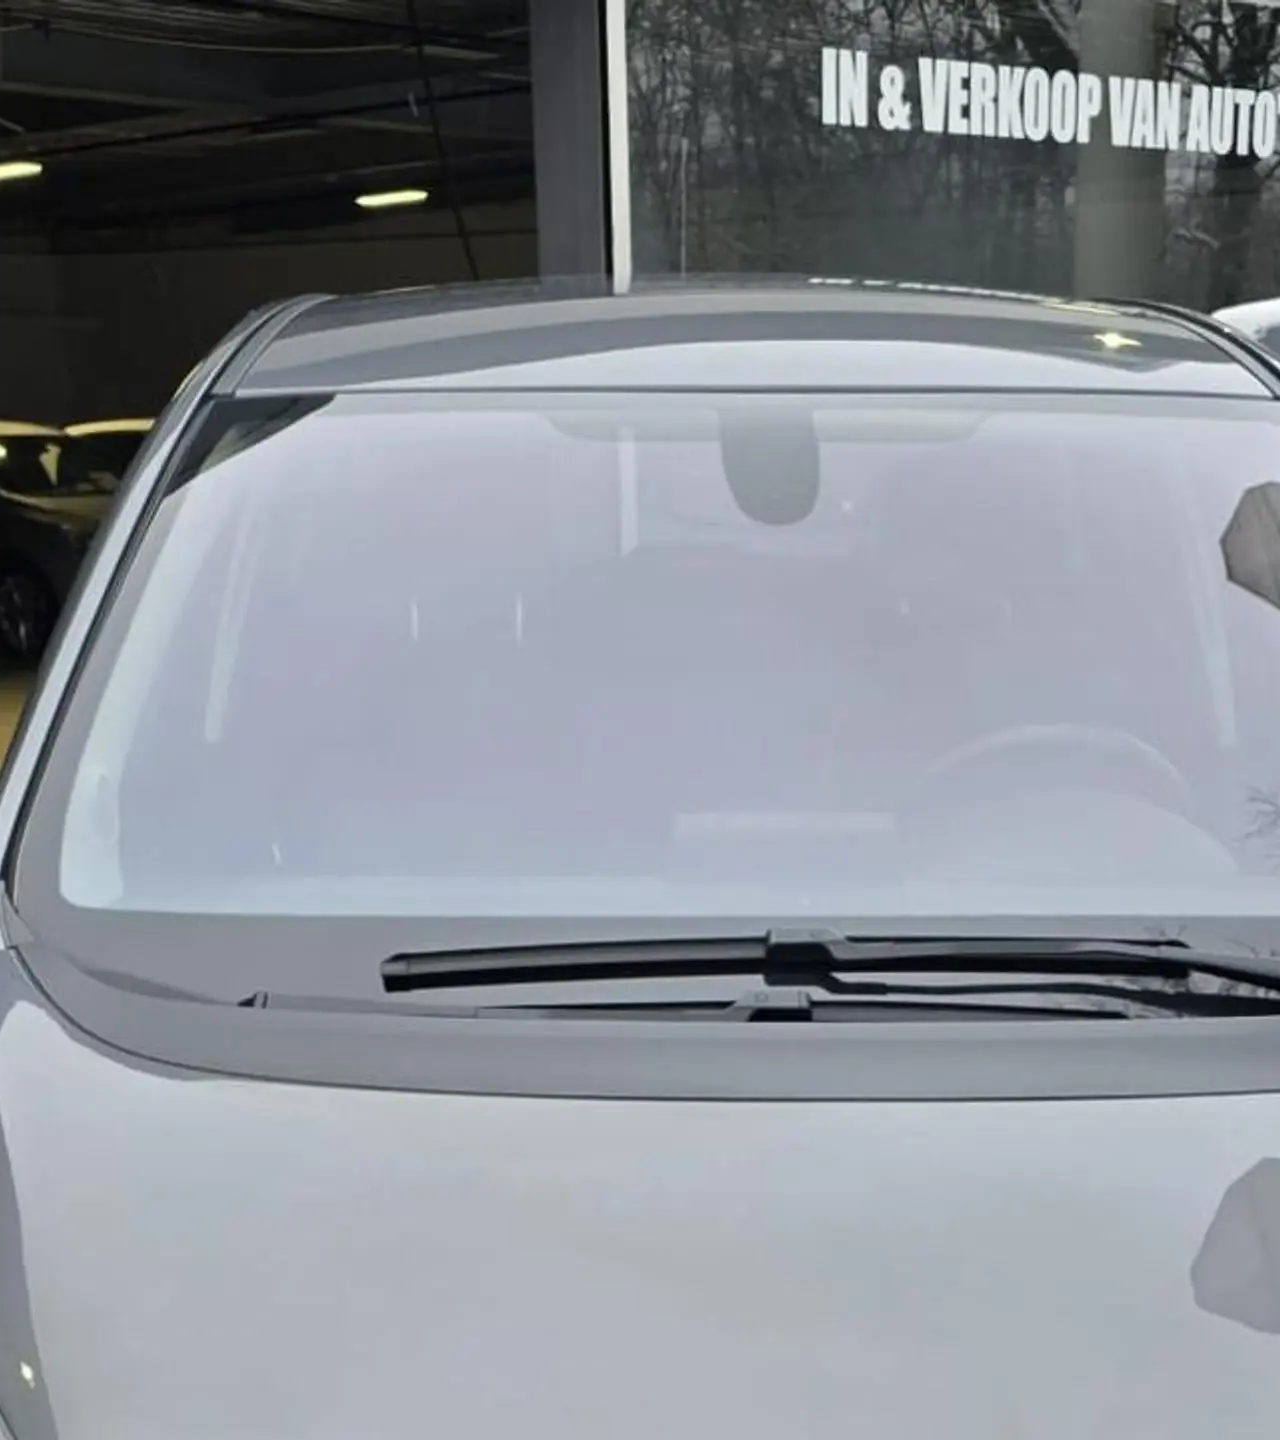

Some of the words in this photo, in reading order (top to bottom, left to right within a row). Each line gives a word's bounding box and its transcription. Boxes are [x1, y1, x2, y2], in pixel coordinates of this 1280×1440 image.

[821, 47, 868, 127] IN
[877, 65, 912, 131] &
[918, 57, 1102, 144] VERKOOP
[1109, 76, 1180, 150] VAN
